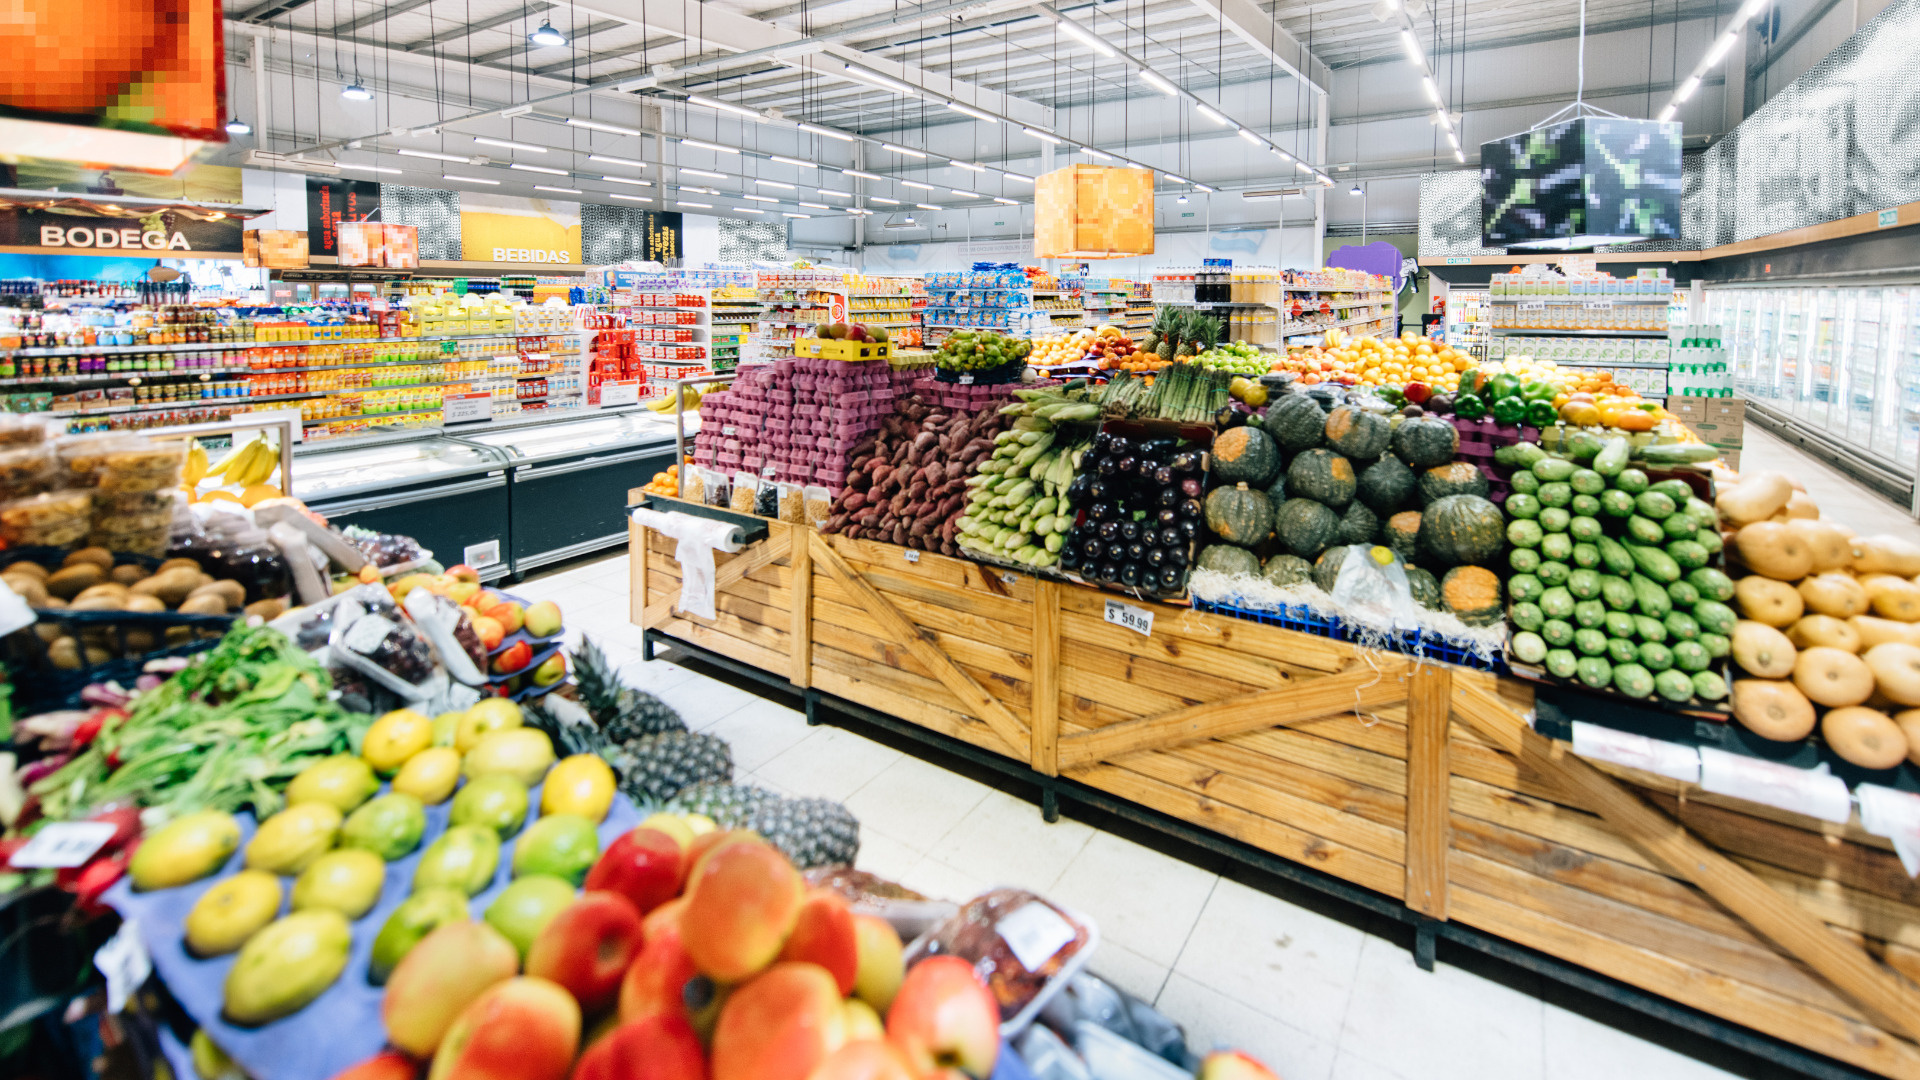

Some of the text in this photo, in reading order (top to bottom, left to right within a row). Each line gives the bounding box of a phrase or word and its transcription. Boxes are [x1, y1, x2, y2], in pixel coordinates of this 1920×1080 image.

[319, 185, 334, 250] agua saborizada
[40, 225, 192, 251] BODEGA
[655, 232, 663, 253] agua
[493, 248, 570, 264] BEBIDAS
[1108, 608, 1149, 631] $ 59.99
